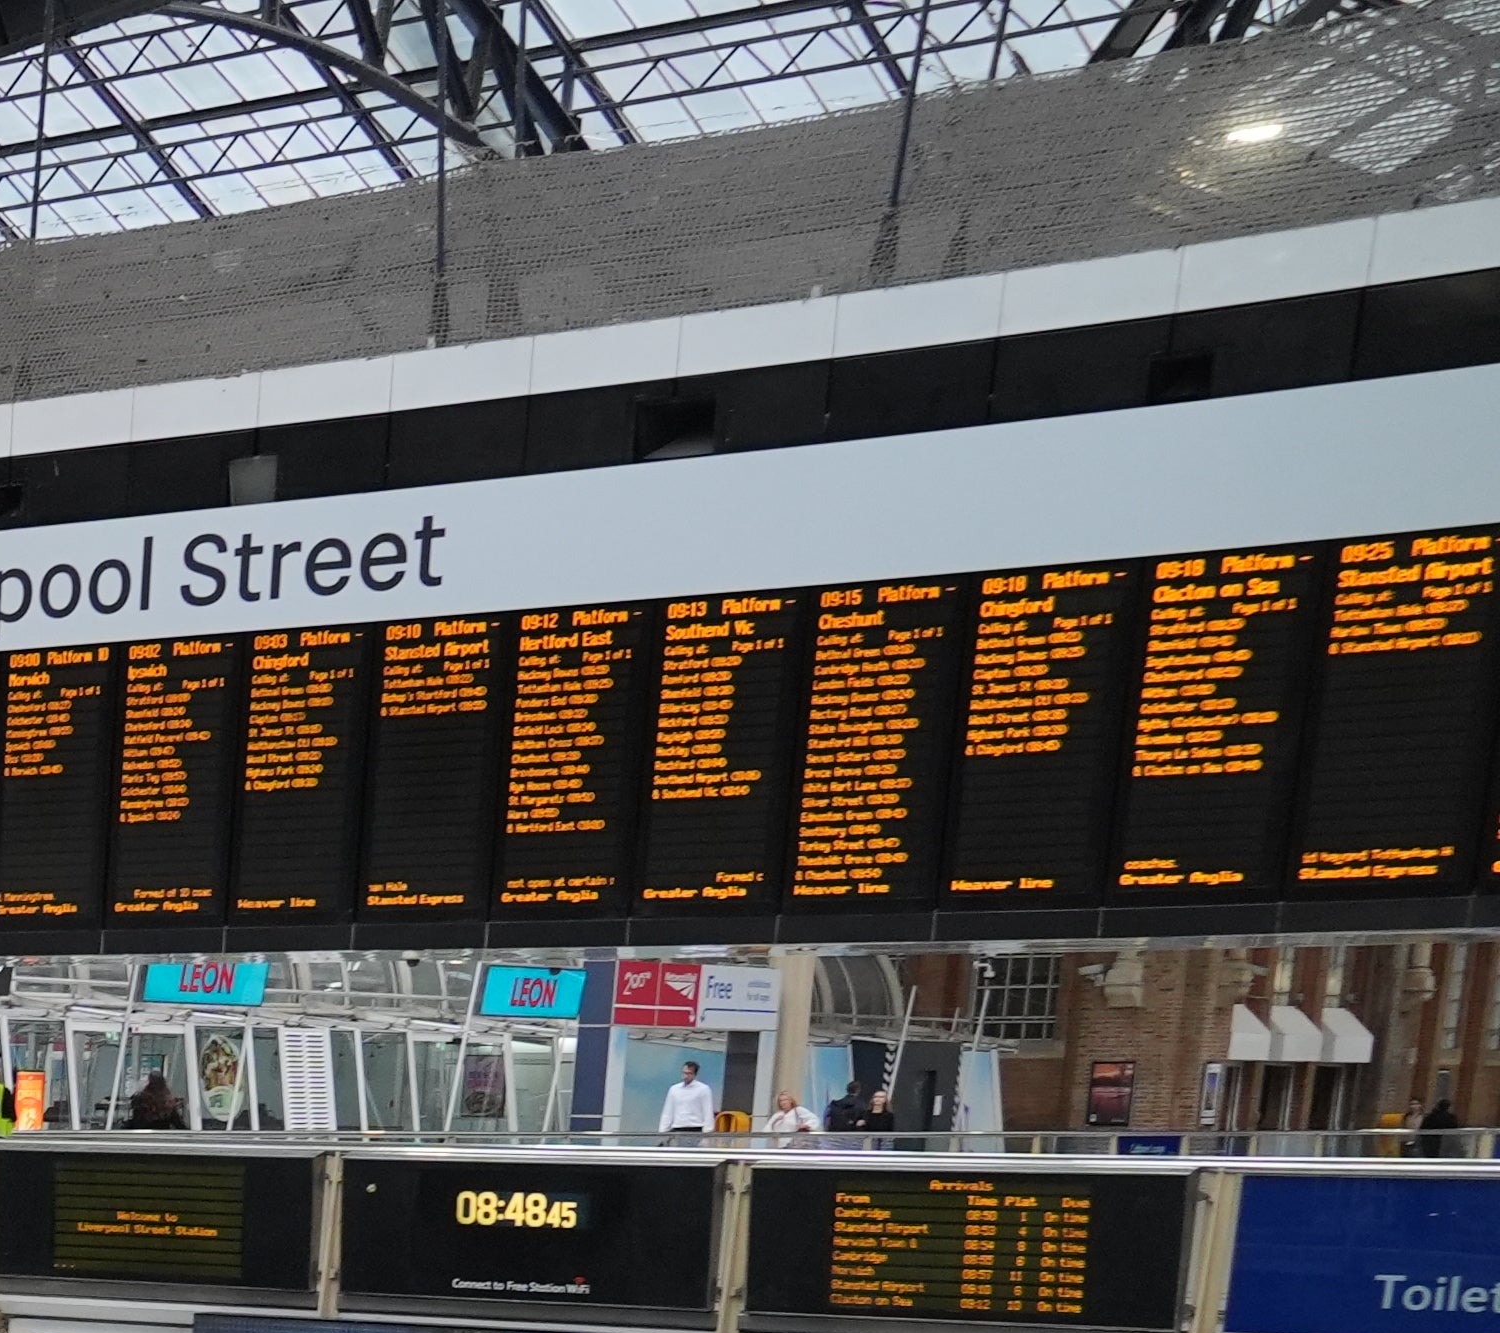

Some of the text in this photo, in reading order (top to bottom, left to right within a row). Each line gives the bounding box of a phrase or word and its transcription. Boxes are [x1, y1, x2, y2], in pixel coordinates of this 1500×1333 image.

[180, 515, 446, 606] Street
[1340, 536, 1492, 564] 09:25 Platform
[1337, 557, 1494, 588] Stansted Airport
[820, 585, 941, 608] 09:15 Platform
[1153, 578, 1281, 604] Clacton on Sea
[667, 597, 782, 620] 09:13 Platform
[979, 595, 1056, 619] Chingford
[434, 620, 487, 637] Platform
[520, 609, 629, 631] 09:12 Platform
[818, 609, 886, 631] Cheshunt
[519, 630, 613, 652] Hertford East
[665, 622, 730, 641] Southend
[172, 640, 222, 656] Platform
[384, 639, 490, 662] Stansted Airport
[127, 663, 168, 681] Ipswich
[253, 652, 310, 671] Chingford
[8, 672, 51, 688] Norwich
[179, 963, 235, 994] LEON
[706, 976, 732, 999] Free
[510, 977, 556, 1009] LEON
[929, 1180, 995, 1192] Arrivals
[835, 1192, 871, 1204] From
[967, 1195, 998, 1207] Time
[1060, 1197, 1091, 1209] Due
[175, 1226, 217, 1237] Station
[452, 1278, 492, 1290] Connect
[493, 1281, 505, 1290] to
[506, 1281, 528, 1292] Free
[529, 1281, 565, 1293] Station
